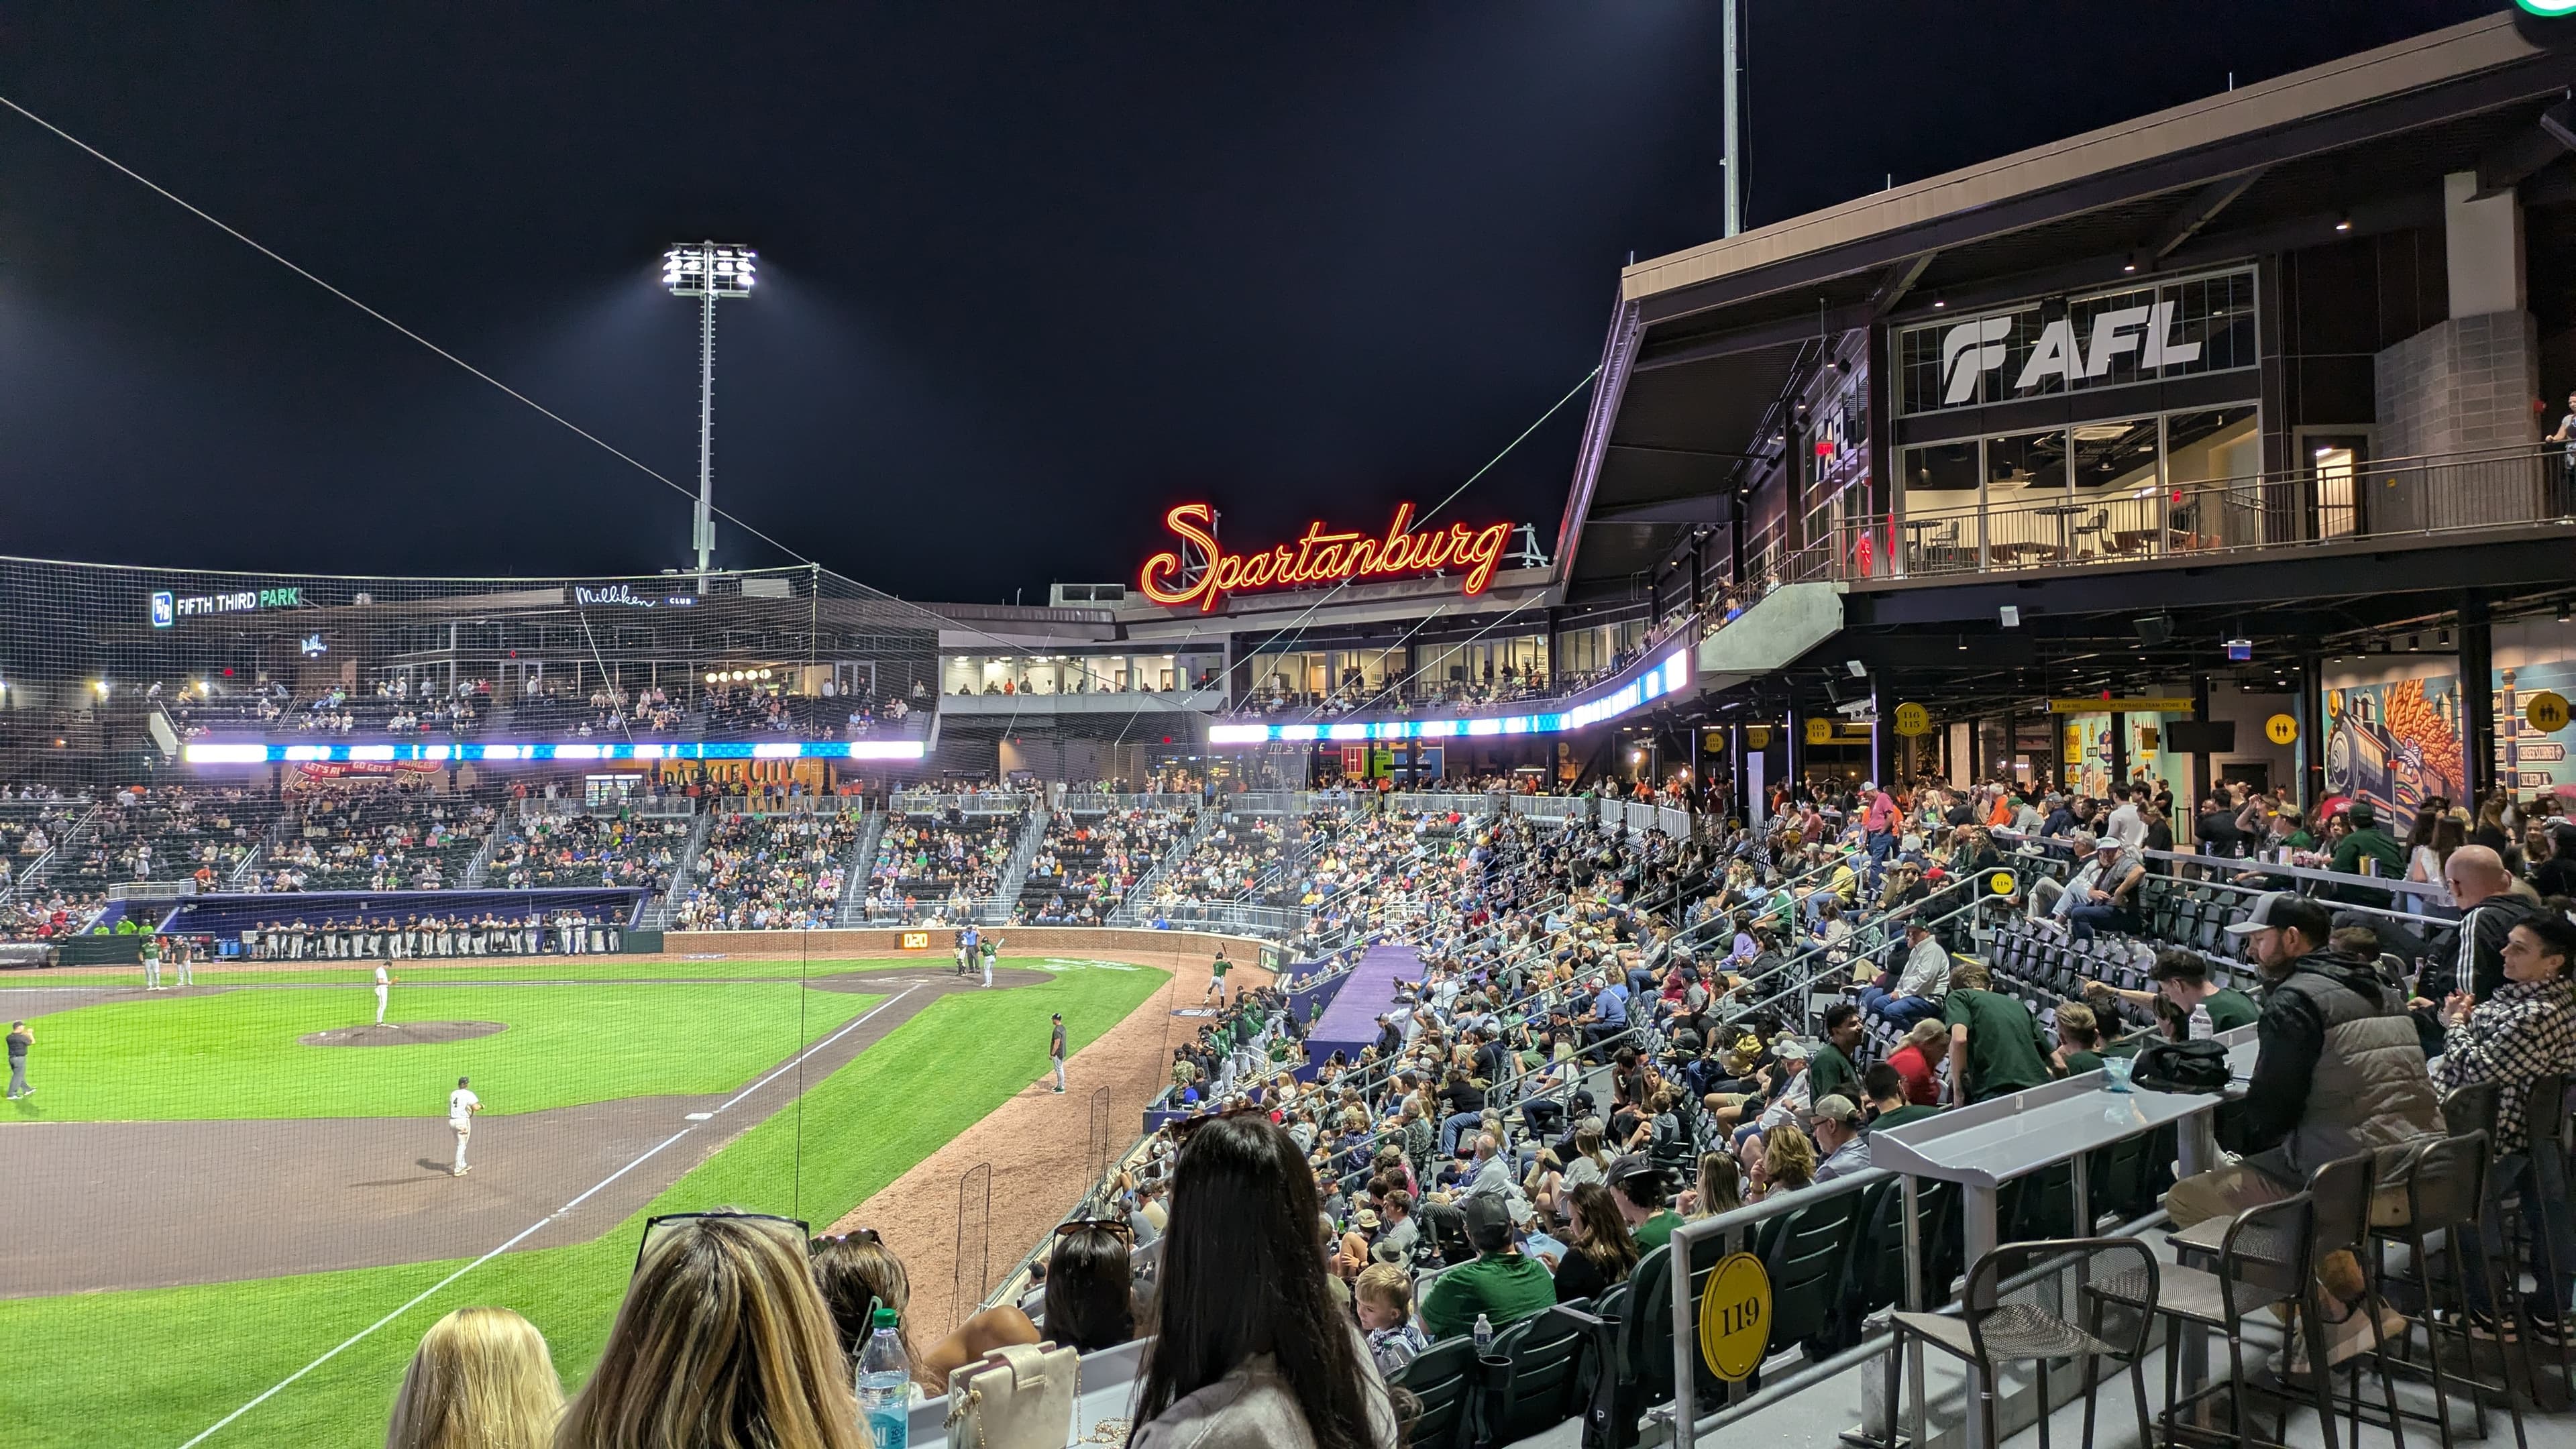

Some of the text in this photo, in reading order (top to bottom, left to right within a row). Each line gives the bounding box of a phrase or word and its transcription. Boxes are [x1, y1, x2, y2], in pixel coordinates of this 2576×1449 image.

[2014, 301, 2202, 389] AFL
[1140, 502, 1512, 611] Spartanburg
[177, 596, 213, 615] FIFTH
[217, 592, 256, 612] THIRD
[260, 588, 299, 607] PARK
[576, 585, 655, 607] Milliken
[1902, 711, 1920, 720] 116
[1903, 720, 1920, 729] 115
[305, 762, 330, 773] LET'S
[353, 762, 366, 770] GO
[368, 763, 383, 771] GET
[749, 759, 796, 782] CITY
[904, 933, 928, 948] 020
[453, 1097, 458, 1108] 4
[1721, 1296, 1760, 1338] 119
[1597, 1409, 1605, 1421] P
